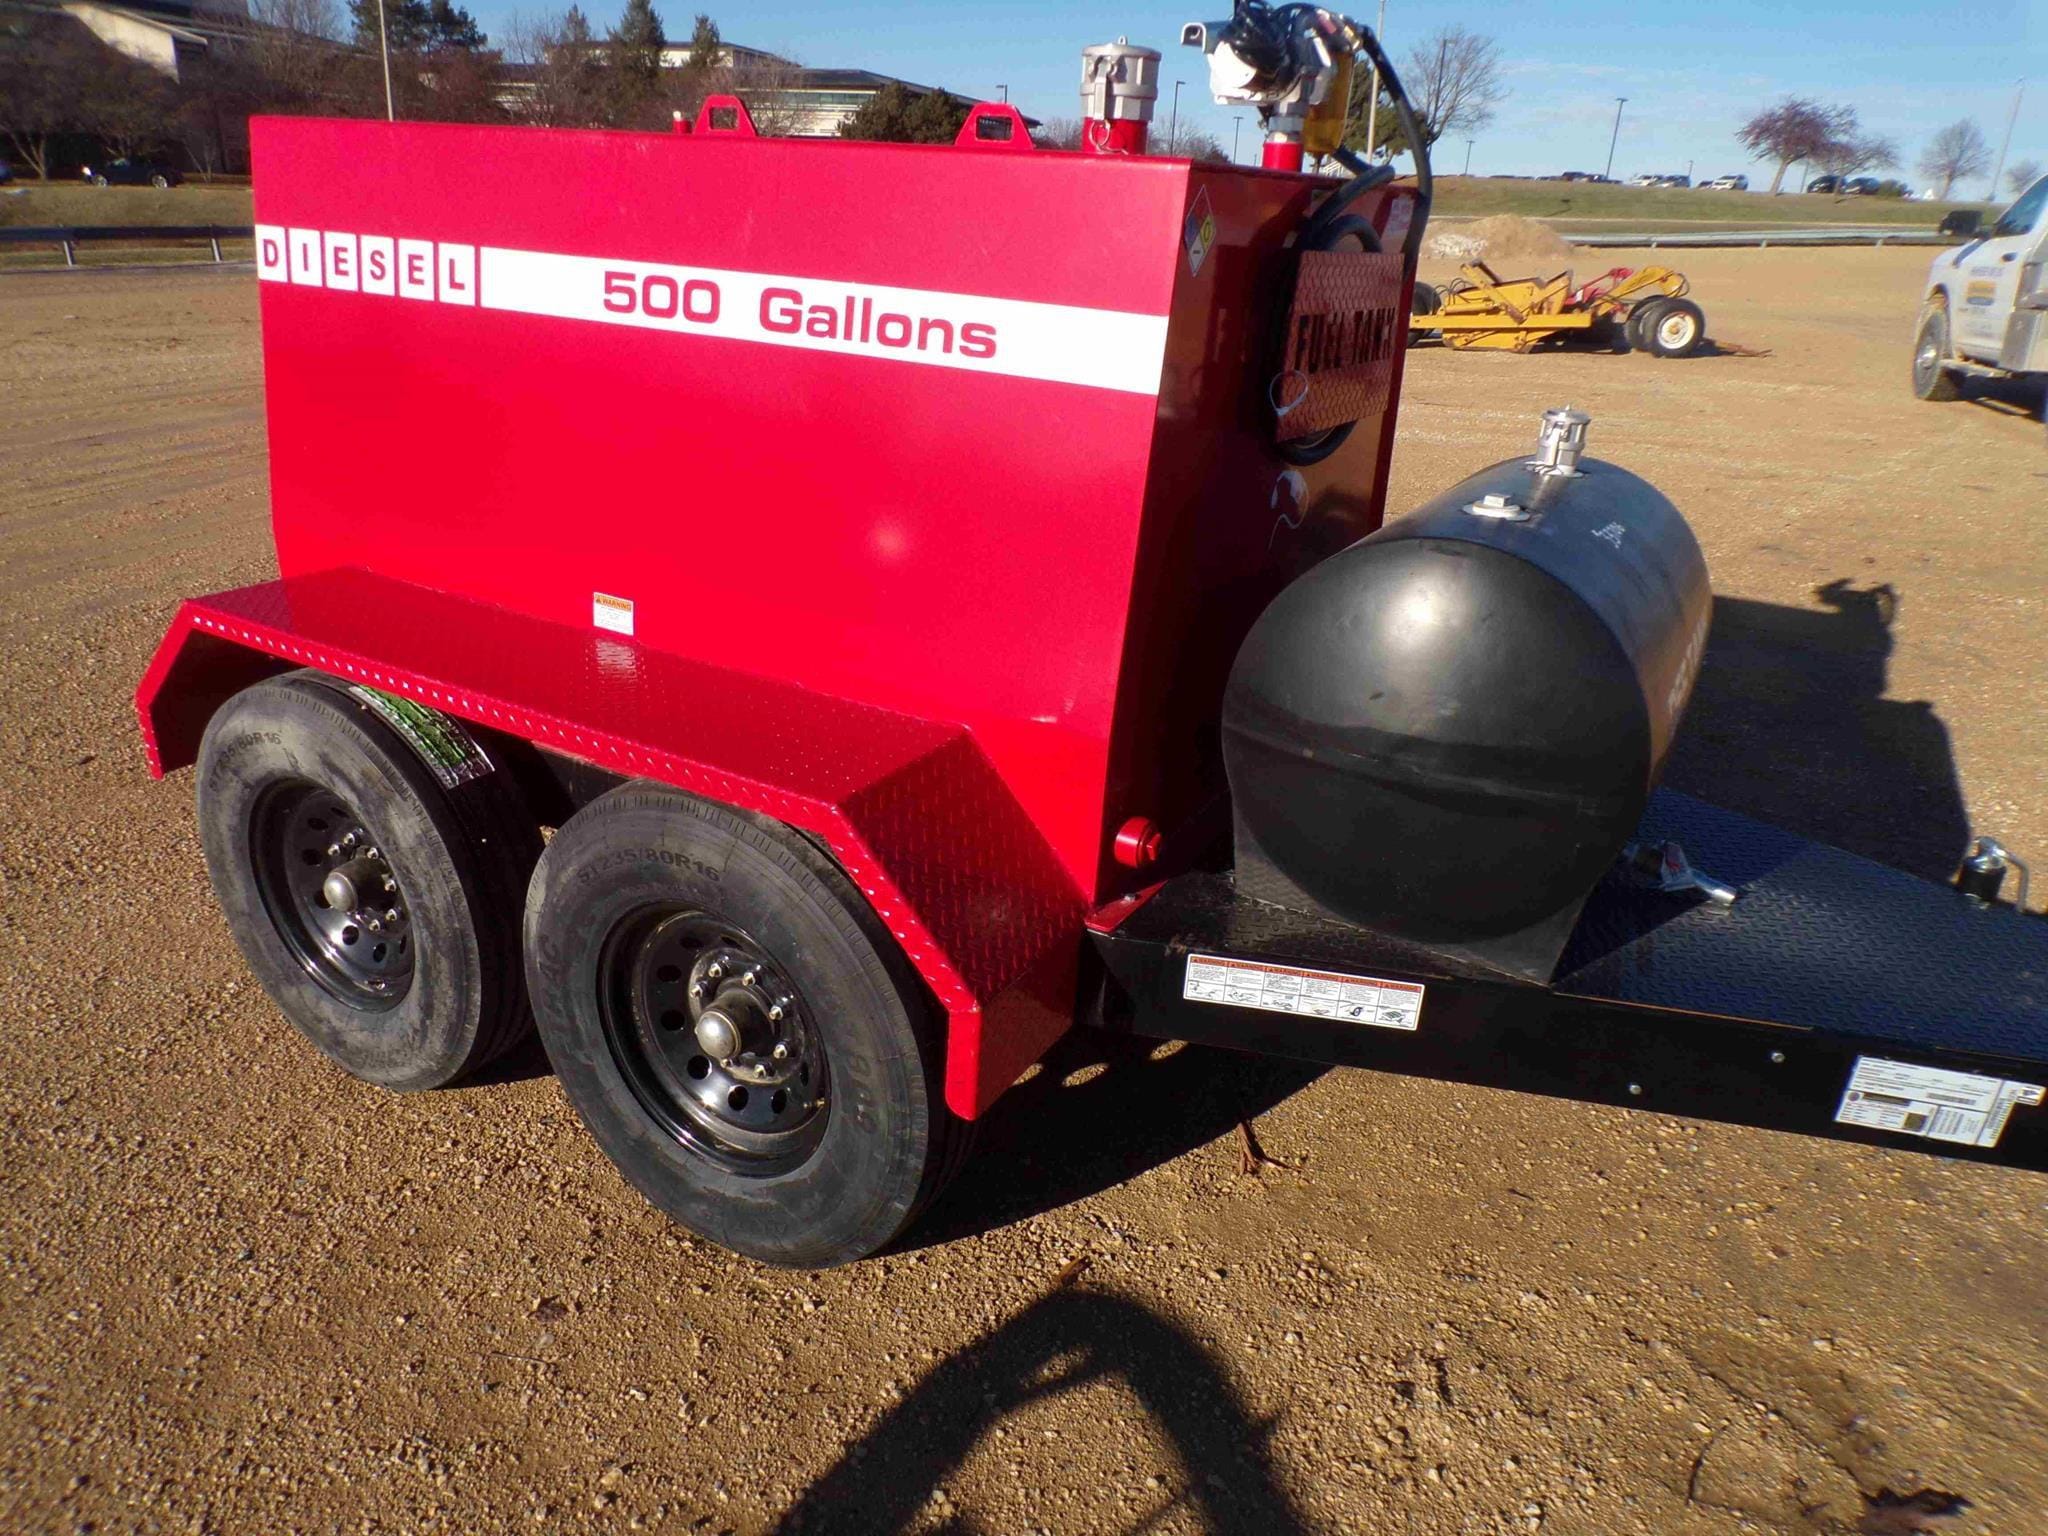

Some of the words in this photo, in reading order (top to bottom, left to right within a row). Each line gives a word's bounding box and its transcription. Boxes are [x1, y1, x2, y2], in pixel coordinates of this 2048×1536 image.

[263, 237, 465, 291] DIESEL
[603, 271, 720, 324] 500
[759, 287, 997, 359] Gallons
